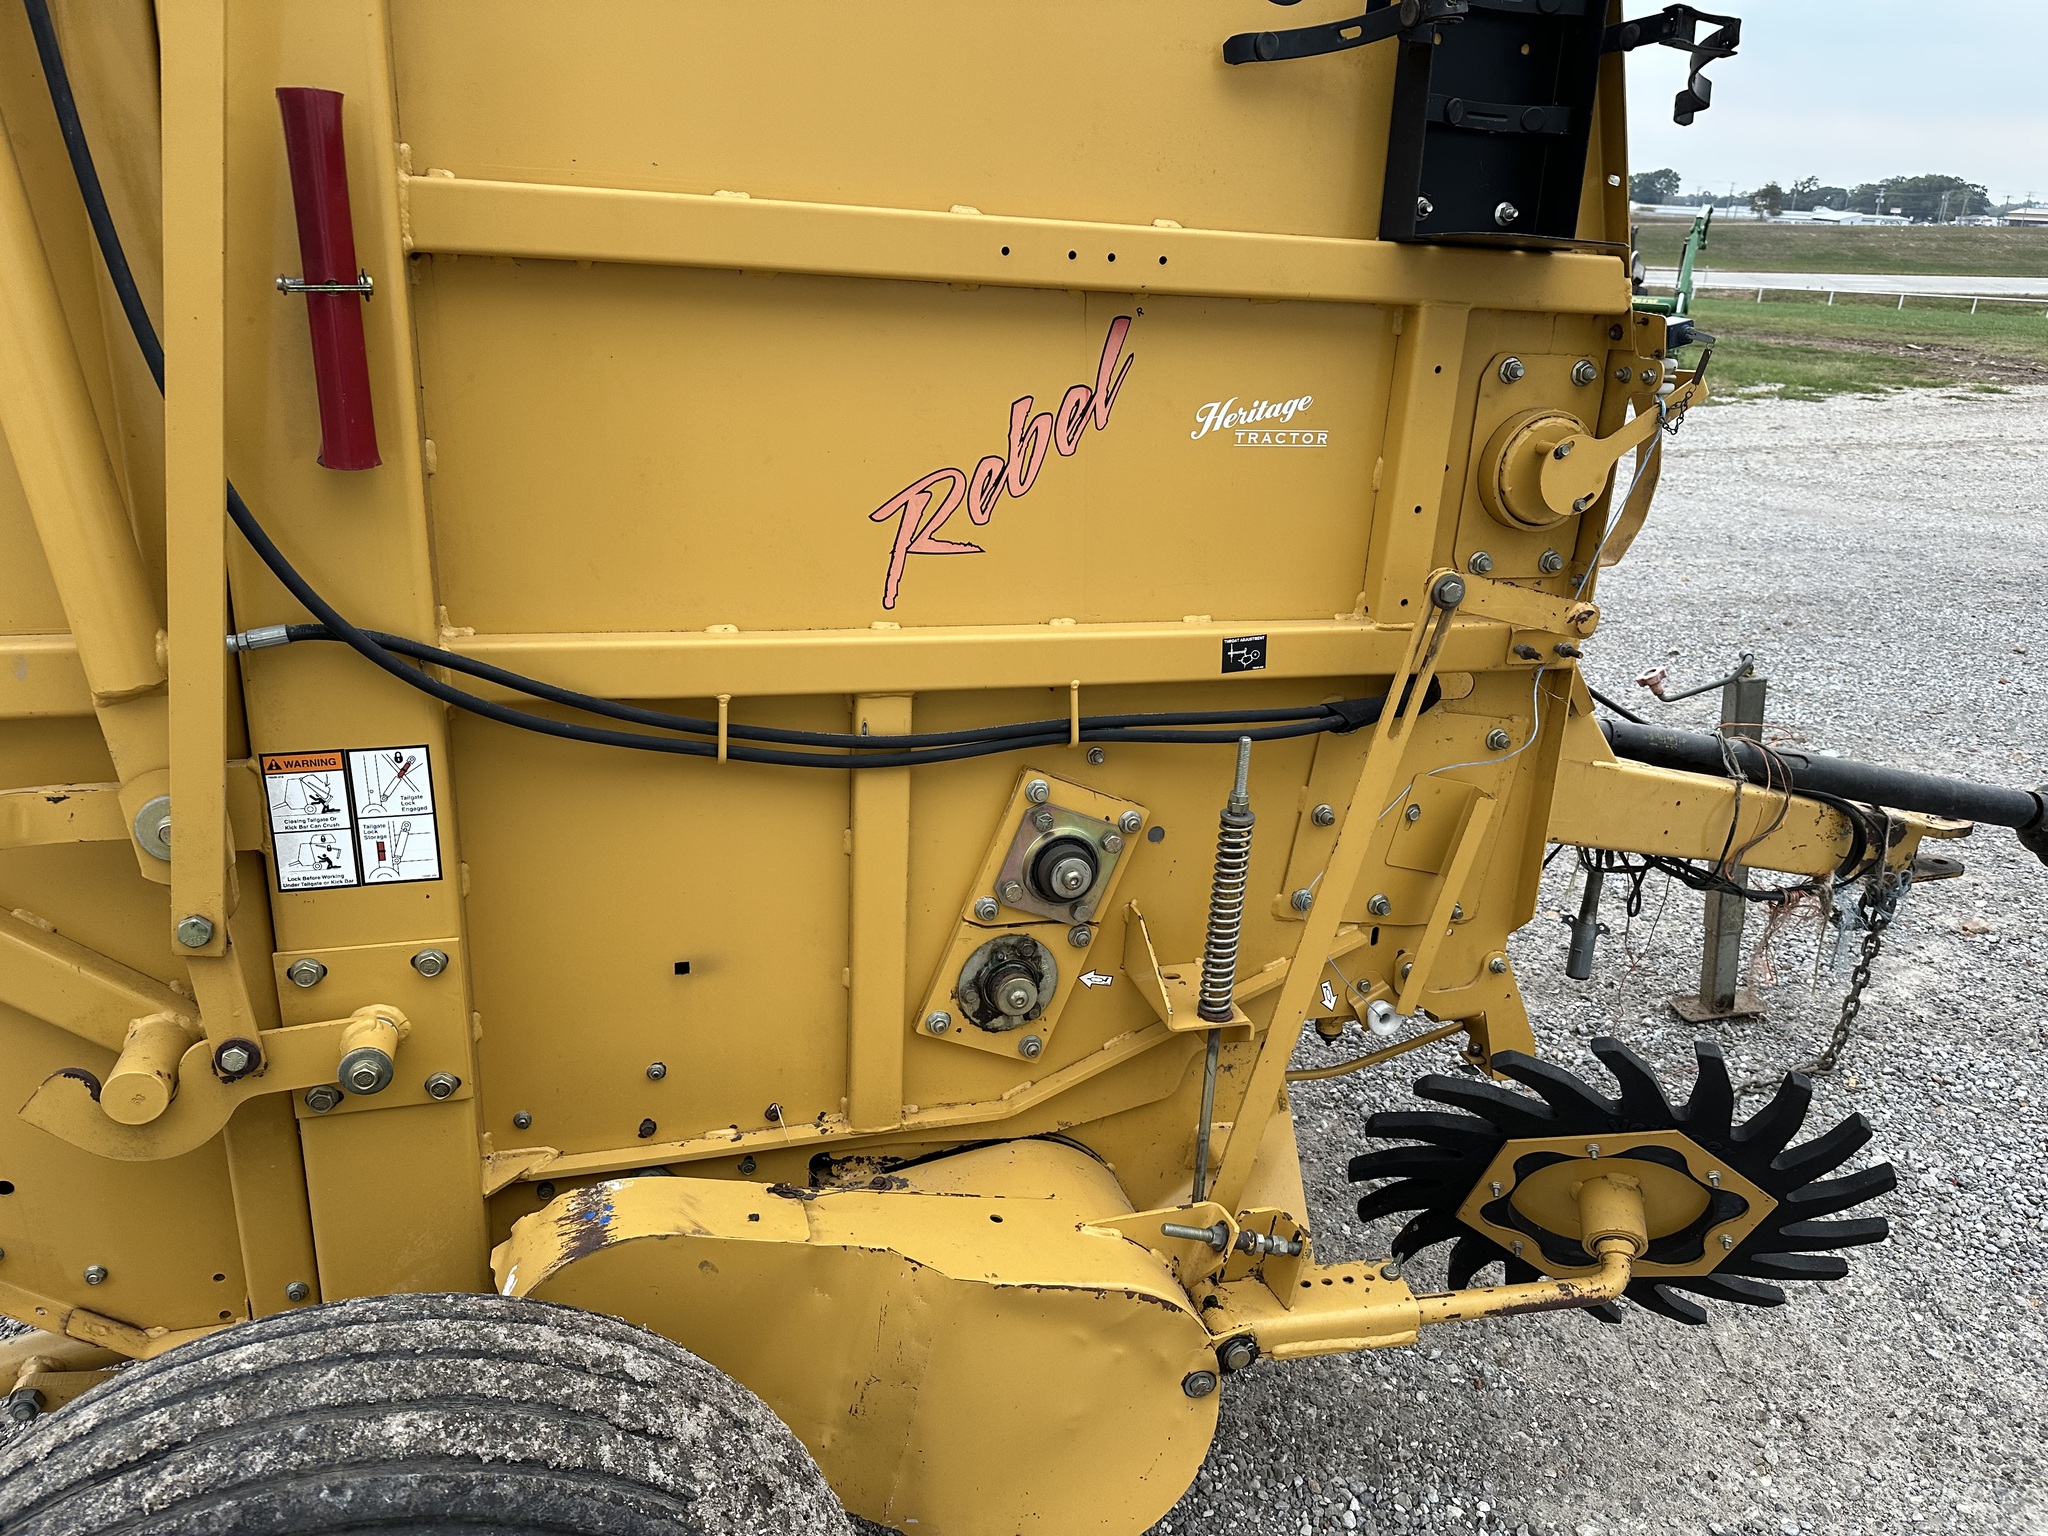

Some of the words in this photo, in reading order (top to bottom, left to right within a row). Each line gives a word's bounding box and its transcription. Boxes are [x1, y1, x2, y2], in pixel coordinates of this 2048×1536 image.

[1190, 395, 1314, 440] Heritage
[1234, 432, 1328, 444] TRACTOR
[868, 315, 1134, 610] Rebel
[283, 757, 337, 768] WARNING
